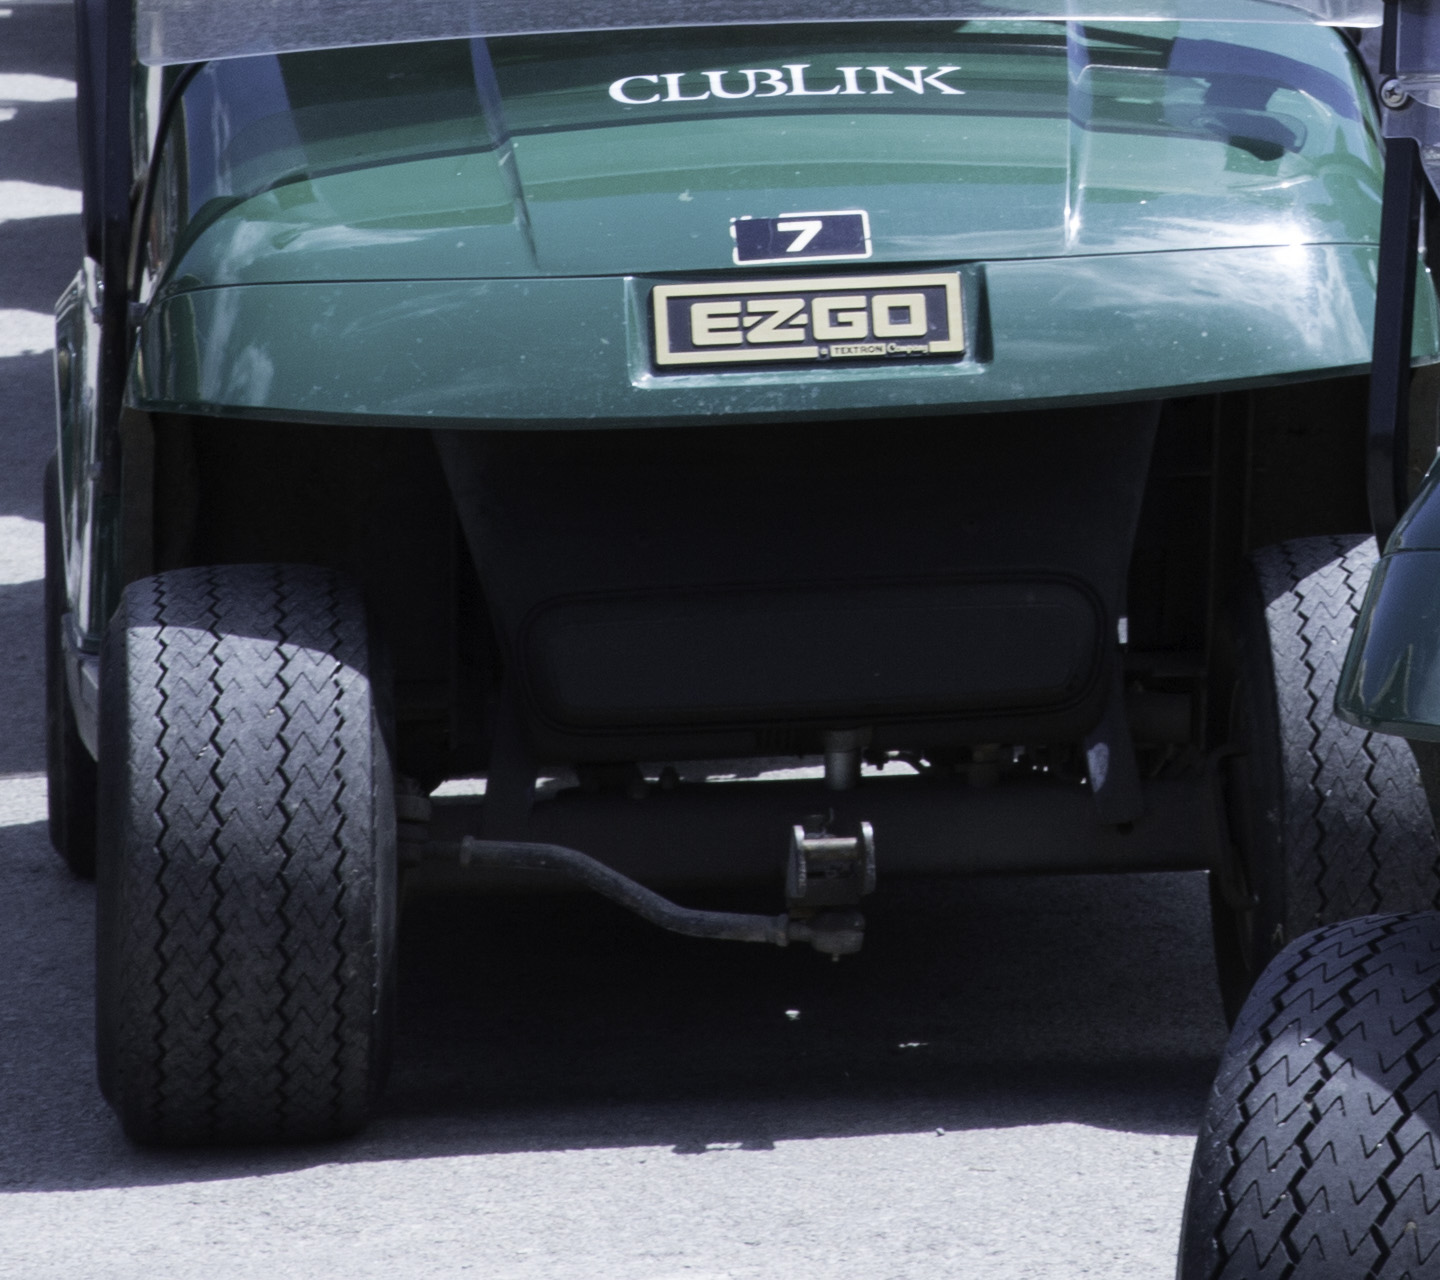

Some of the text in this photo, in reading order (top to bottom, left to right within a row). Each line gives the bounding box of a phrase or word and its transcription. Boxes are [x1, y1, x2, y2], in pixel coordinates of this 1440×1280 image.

[609, 64, 965, 104] CLUBLINK
[777, 221, 823, 252] 7
[834, 345, 883, 355] TEXTRON
